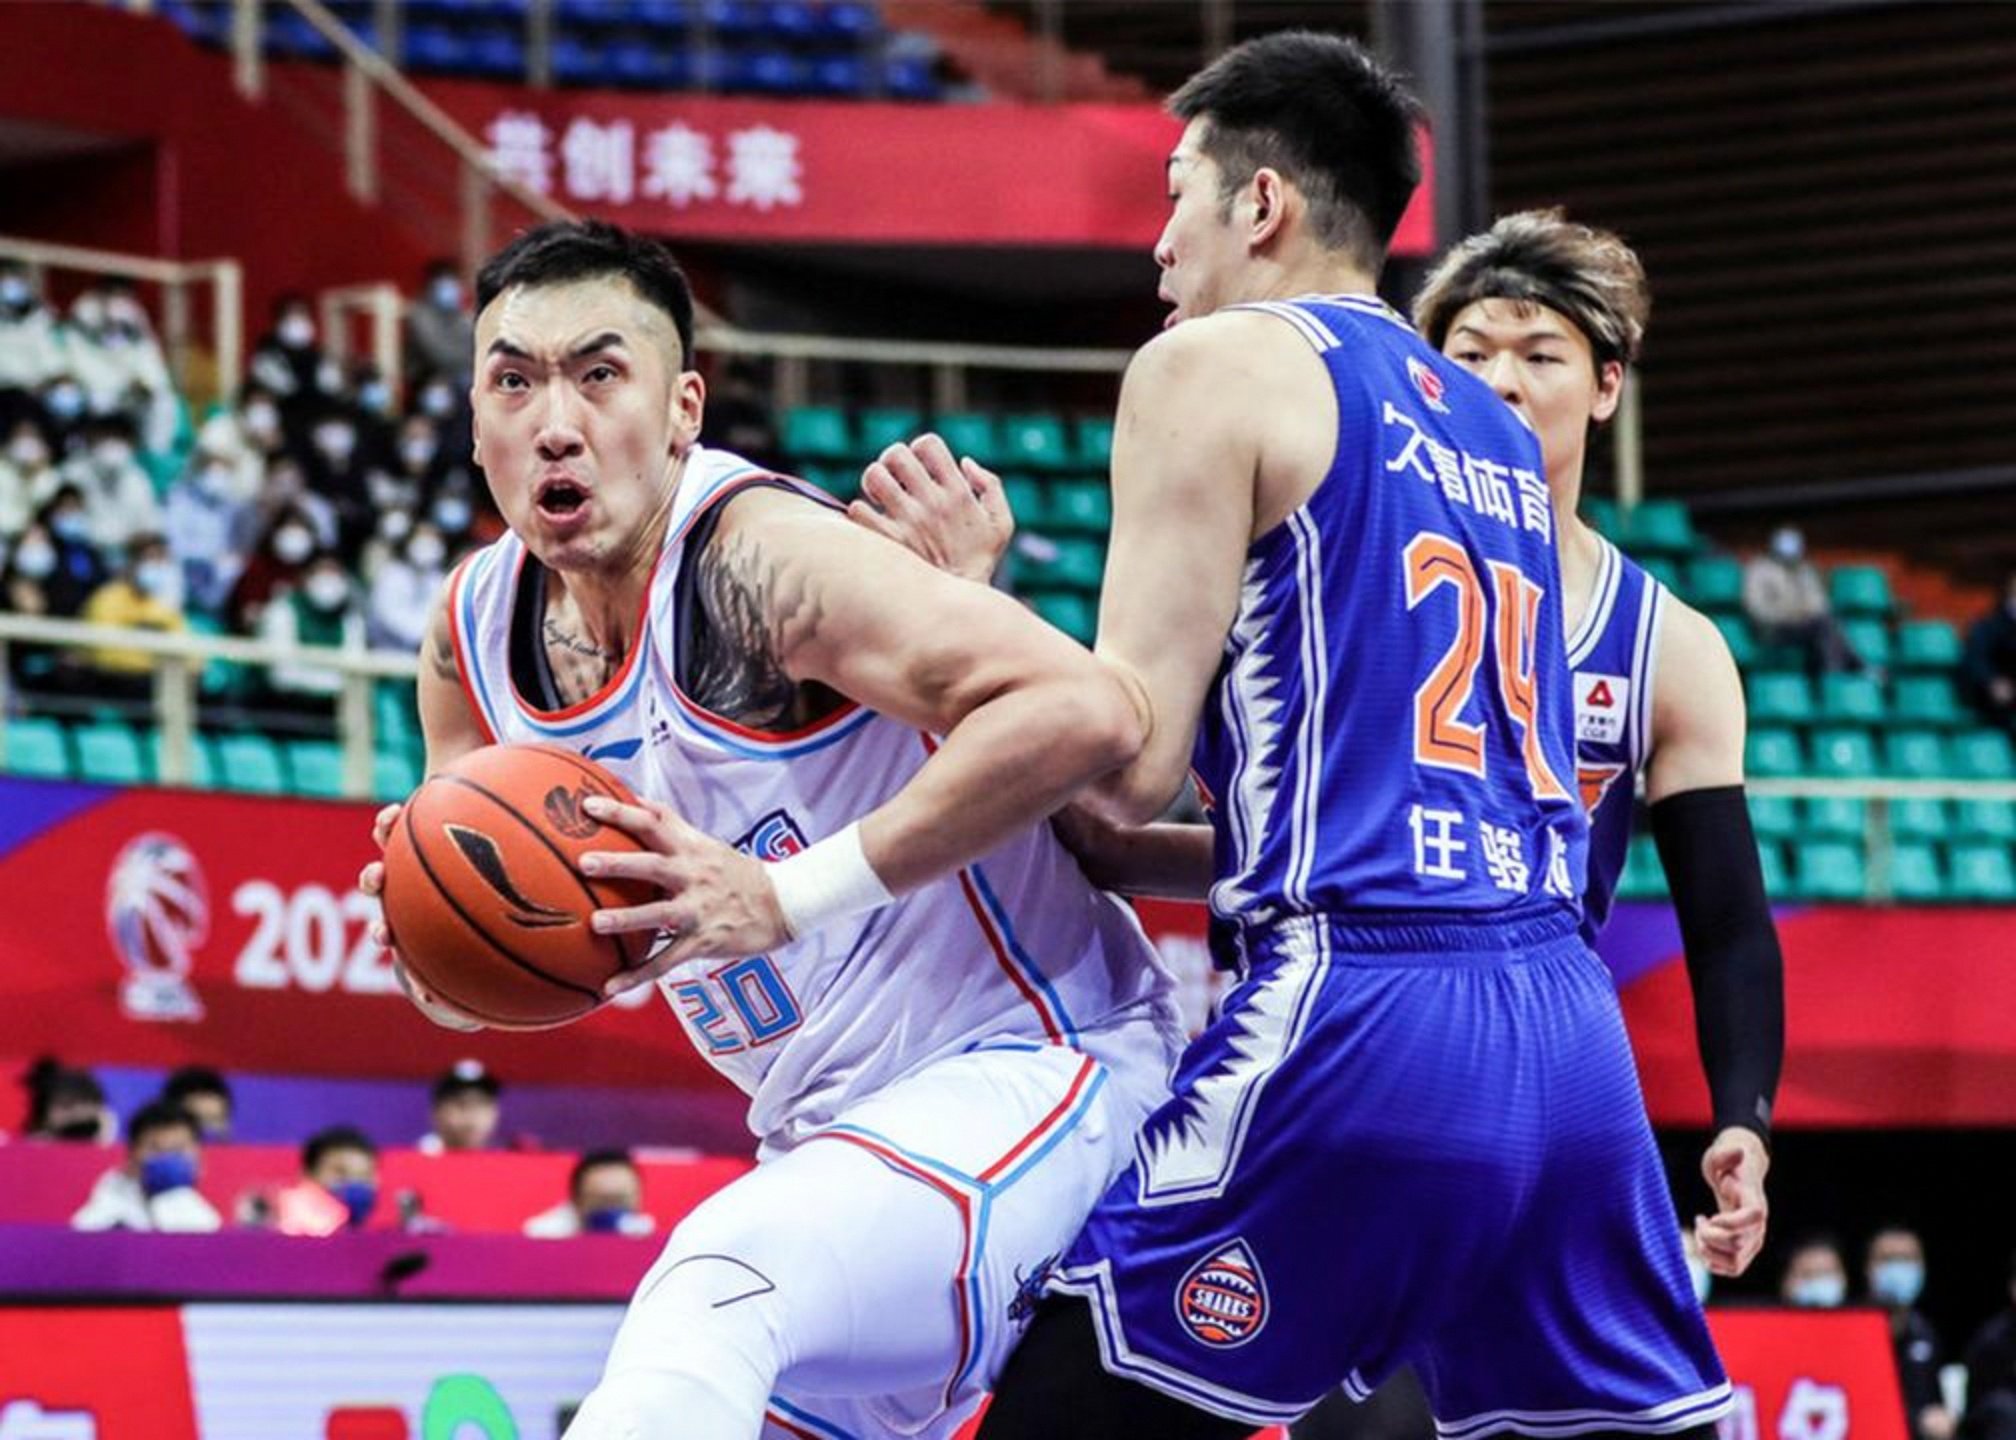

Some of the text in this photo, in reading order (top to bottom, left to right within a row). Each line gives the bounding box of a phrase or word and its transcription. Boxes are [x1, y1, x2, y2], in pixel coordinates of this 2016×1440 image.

[487, 111, 802, 211] 共创未来
[1403, 531, 1573, 799] 24
[670, 951, 804, 1056] 20
